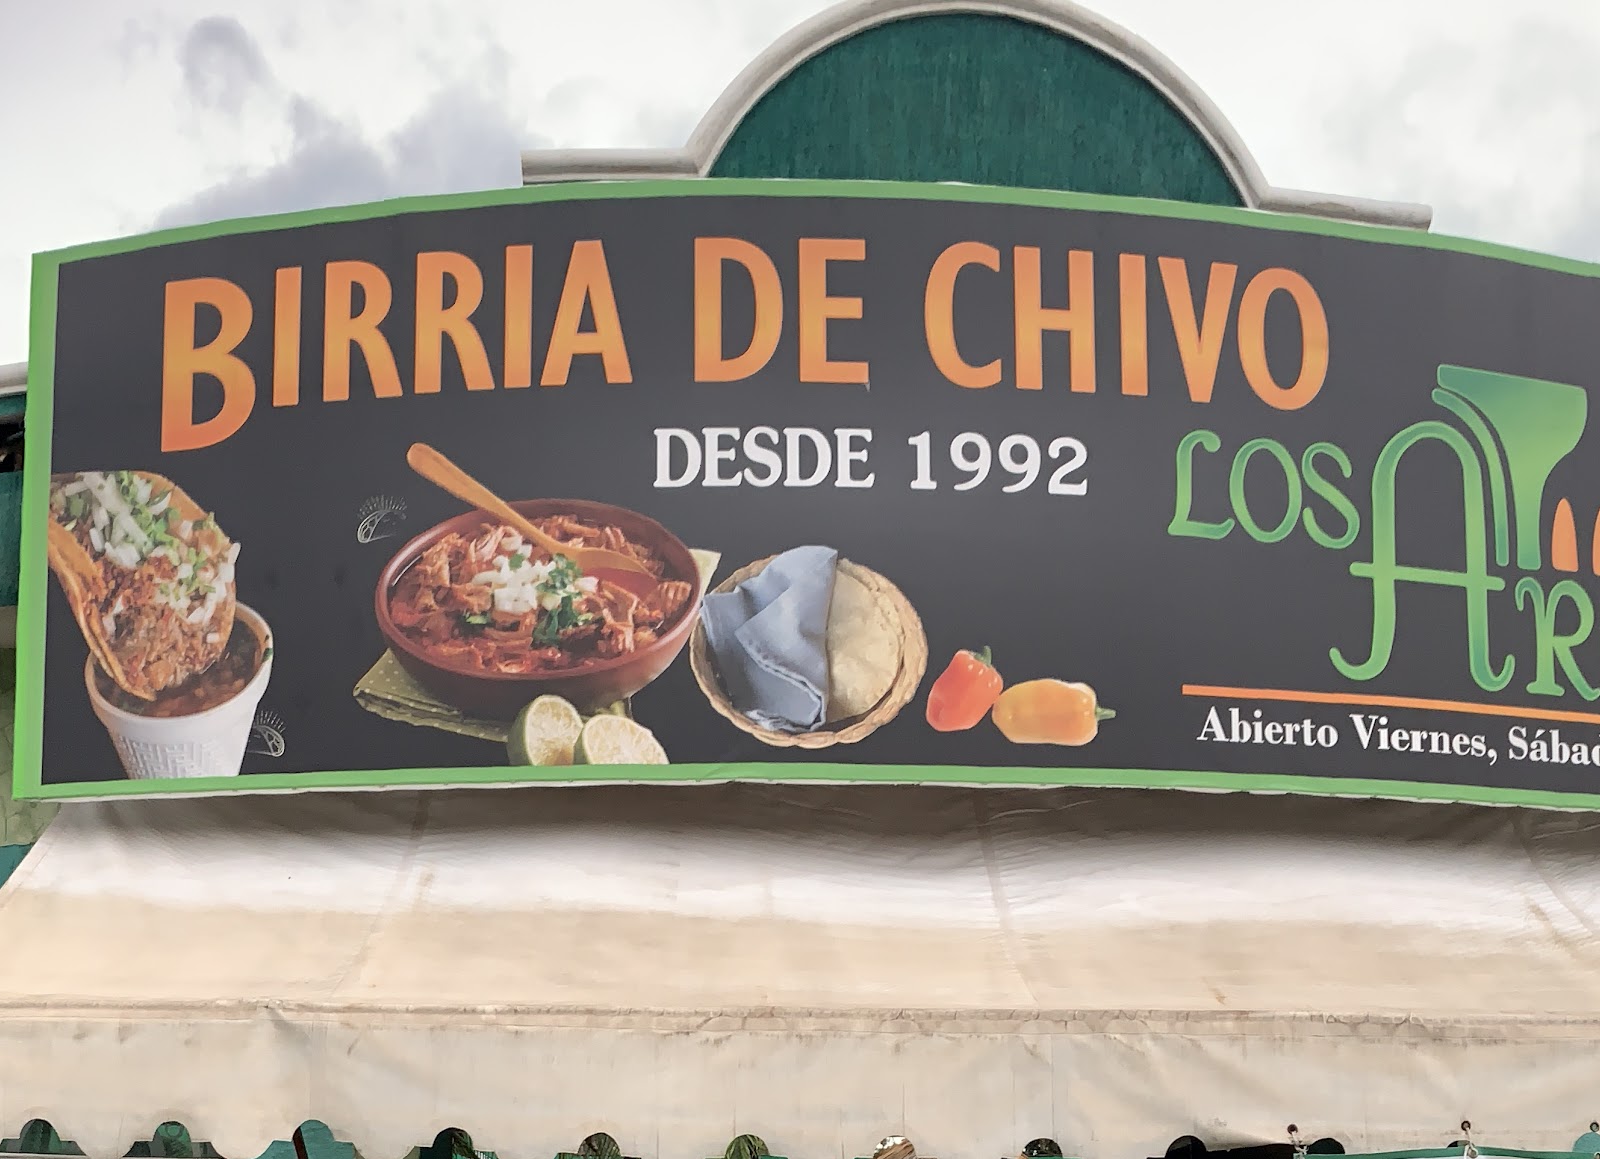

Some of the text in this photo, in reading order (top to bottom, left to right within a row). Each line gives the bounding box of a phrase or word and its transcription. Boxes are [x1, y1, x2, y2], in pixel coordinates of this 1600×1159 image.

[160, 236, 1331, 453] BIRRIA DE CHIVO
[652, 427, 1090, 497] DESDE 1992
[1167, 429, 1362, 550] LOS
[1197, 705, 1339, 750] Abierto
[1349, 713, 1499, 767] Viernes,
